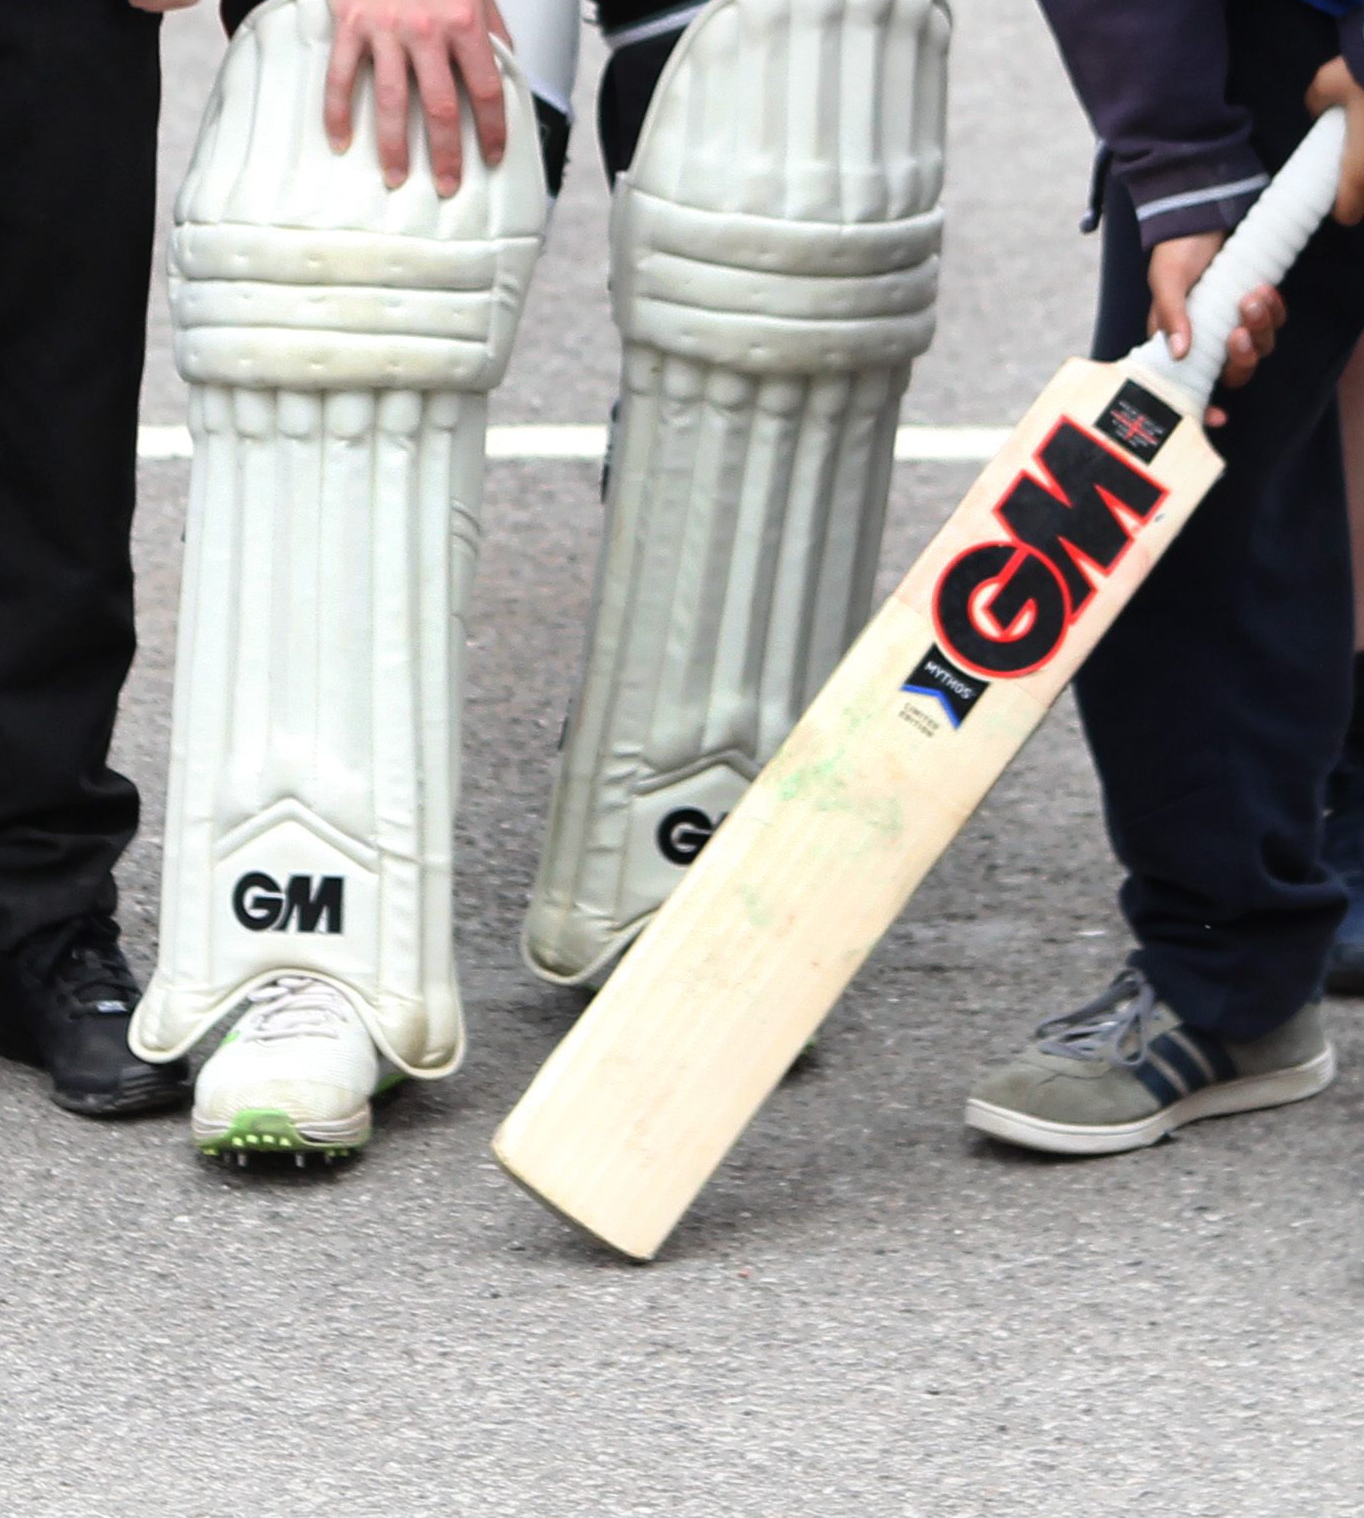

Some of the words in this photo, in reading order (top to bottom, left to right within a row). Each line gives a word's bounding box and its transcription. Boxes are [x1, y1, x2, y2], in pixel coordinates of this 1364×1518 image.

[932, 413, 1171, 679] GM
[924, 661, 973, 700] MYTHOS
[655, 805, 730, 867] G
[233, 870, 345, 934] GM
